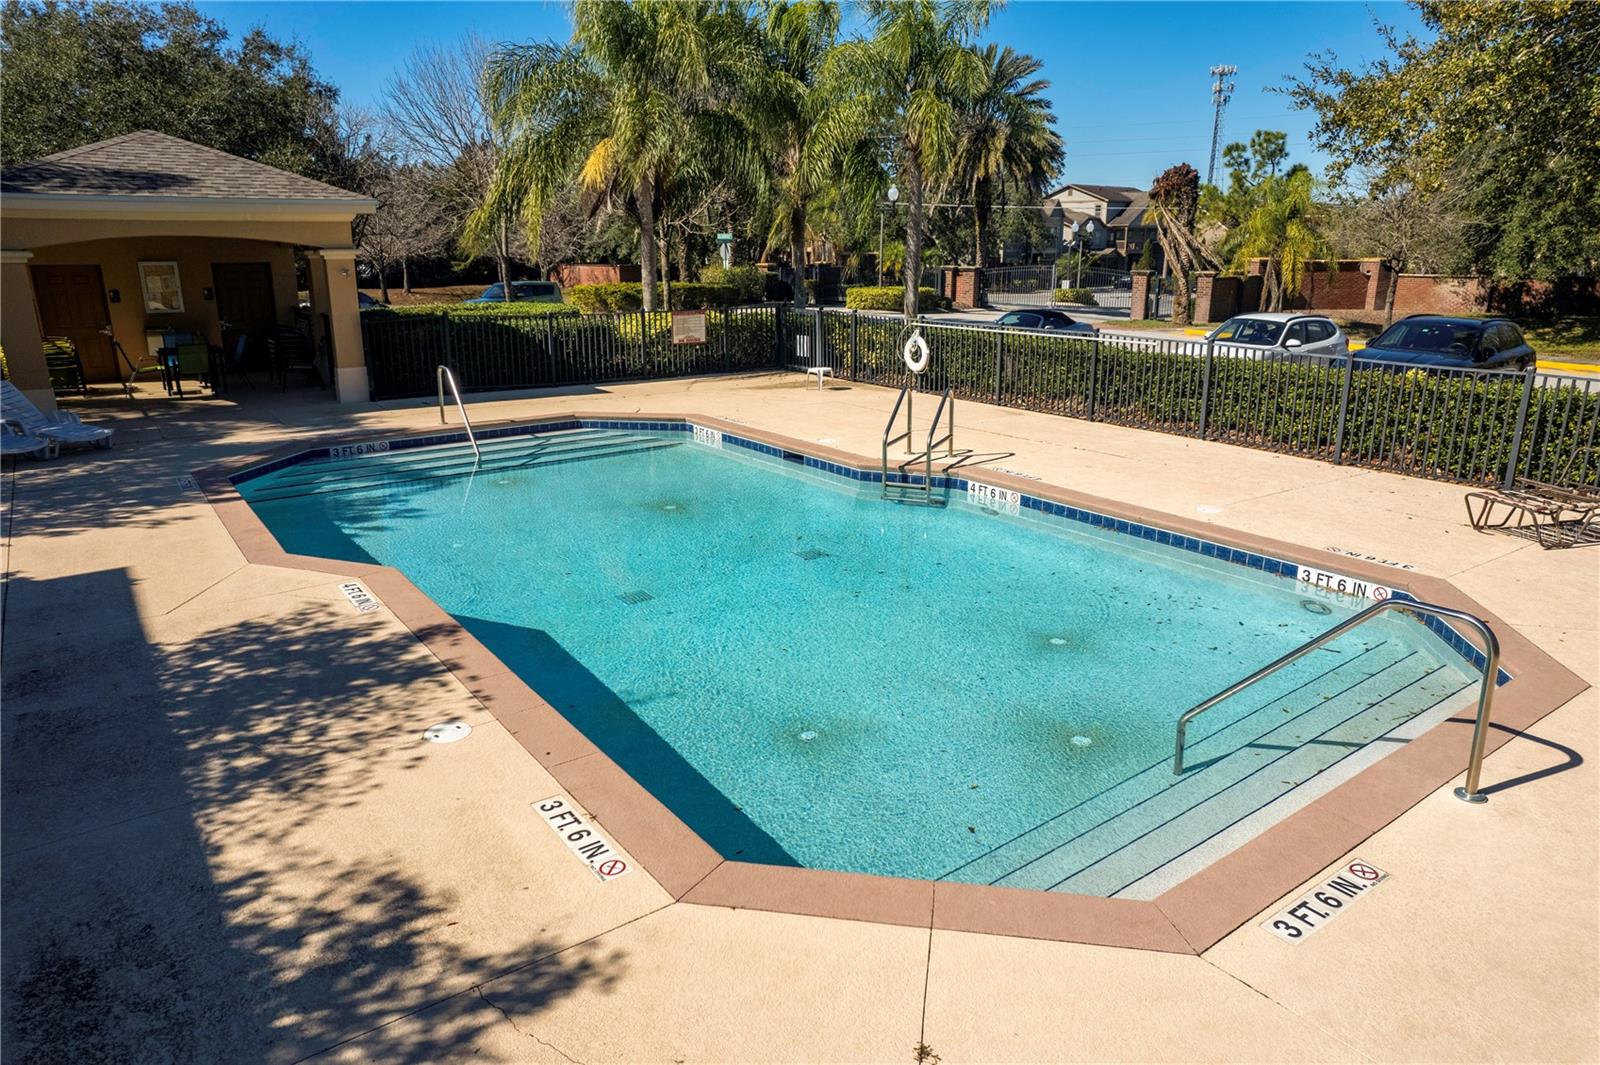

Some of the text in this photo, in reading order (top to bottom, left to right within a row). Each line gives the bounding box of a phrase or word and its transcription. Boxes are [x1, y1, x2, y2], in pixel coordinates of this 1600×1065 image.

[333, 447, 340, 457] 3
[356, 445, 364, 455] 6
[970, 483, 976, 493] 4
[990, 488, 997, 499] 6
[1302, 569, 1370, 599] 3 FT. 6 IN.
[540, 800, 563, 812] 3
[549, 811, 582, 831] FT.
[567, 829, 592, 842] 6
[578, 840, 610, 863] IN.
[1327, 876, 1368, 898] IN.
[1314, 891, 1343, 909] 6
[1287, 900, 1330, 927] FT.
[1273, 920, 1303, 938] 3
